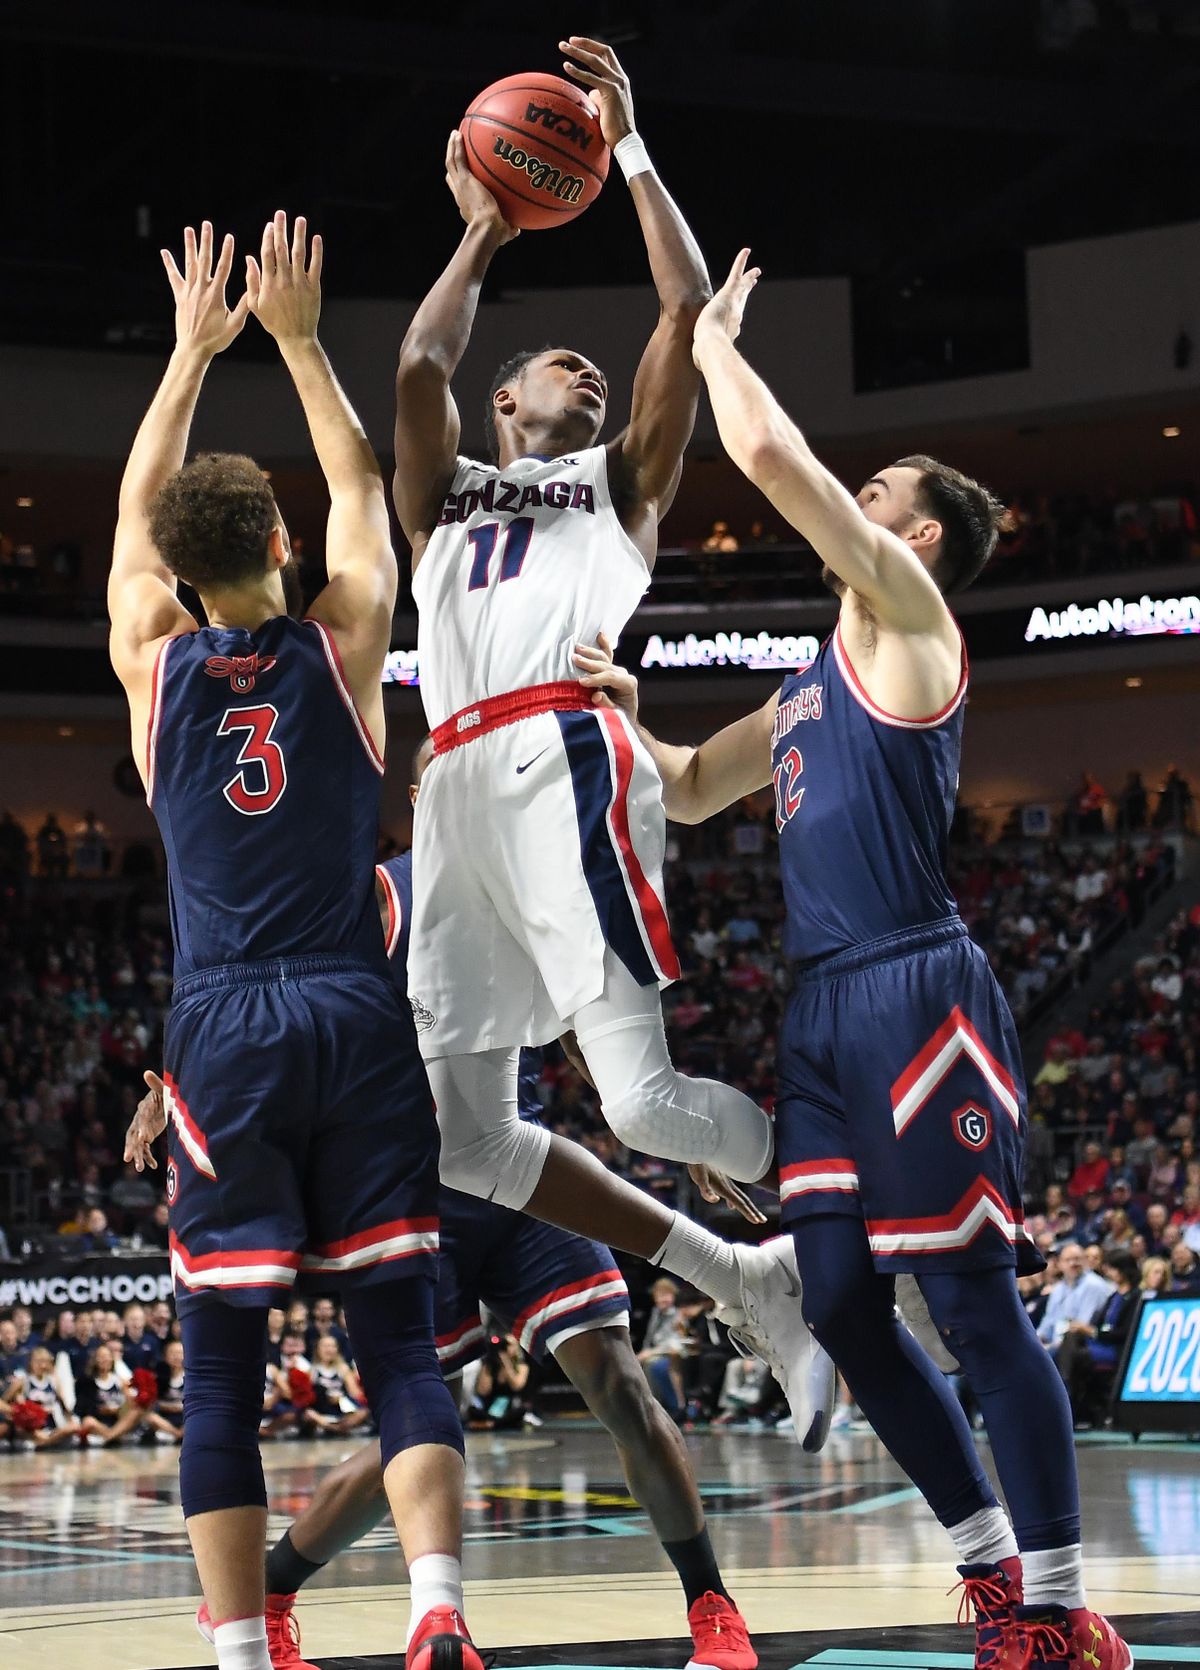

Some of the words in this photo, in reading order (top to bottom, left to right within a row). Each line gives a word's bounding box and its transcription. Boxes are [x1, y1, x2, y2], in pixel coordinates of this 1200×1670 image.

[524, 102, 594, 150] NCAA
[493, 135, 585, 204] Wilson
[437, 479, 595, 527] GONZAGA
[467, 516, 535, 592] 11
[1024, 595, 1200, 641] AutoNation
[641, 631, 819, 667] AutoNation
[216, 703, 287, 815] 3
[772, 746, 805, 834] 12
[966, 1117, 981, 1140] G
[1129, 1308, 1200, 1393] 202
